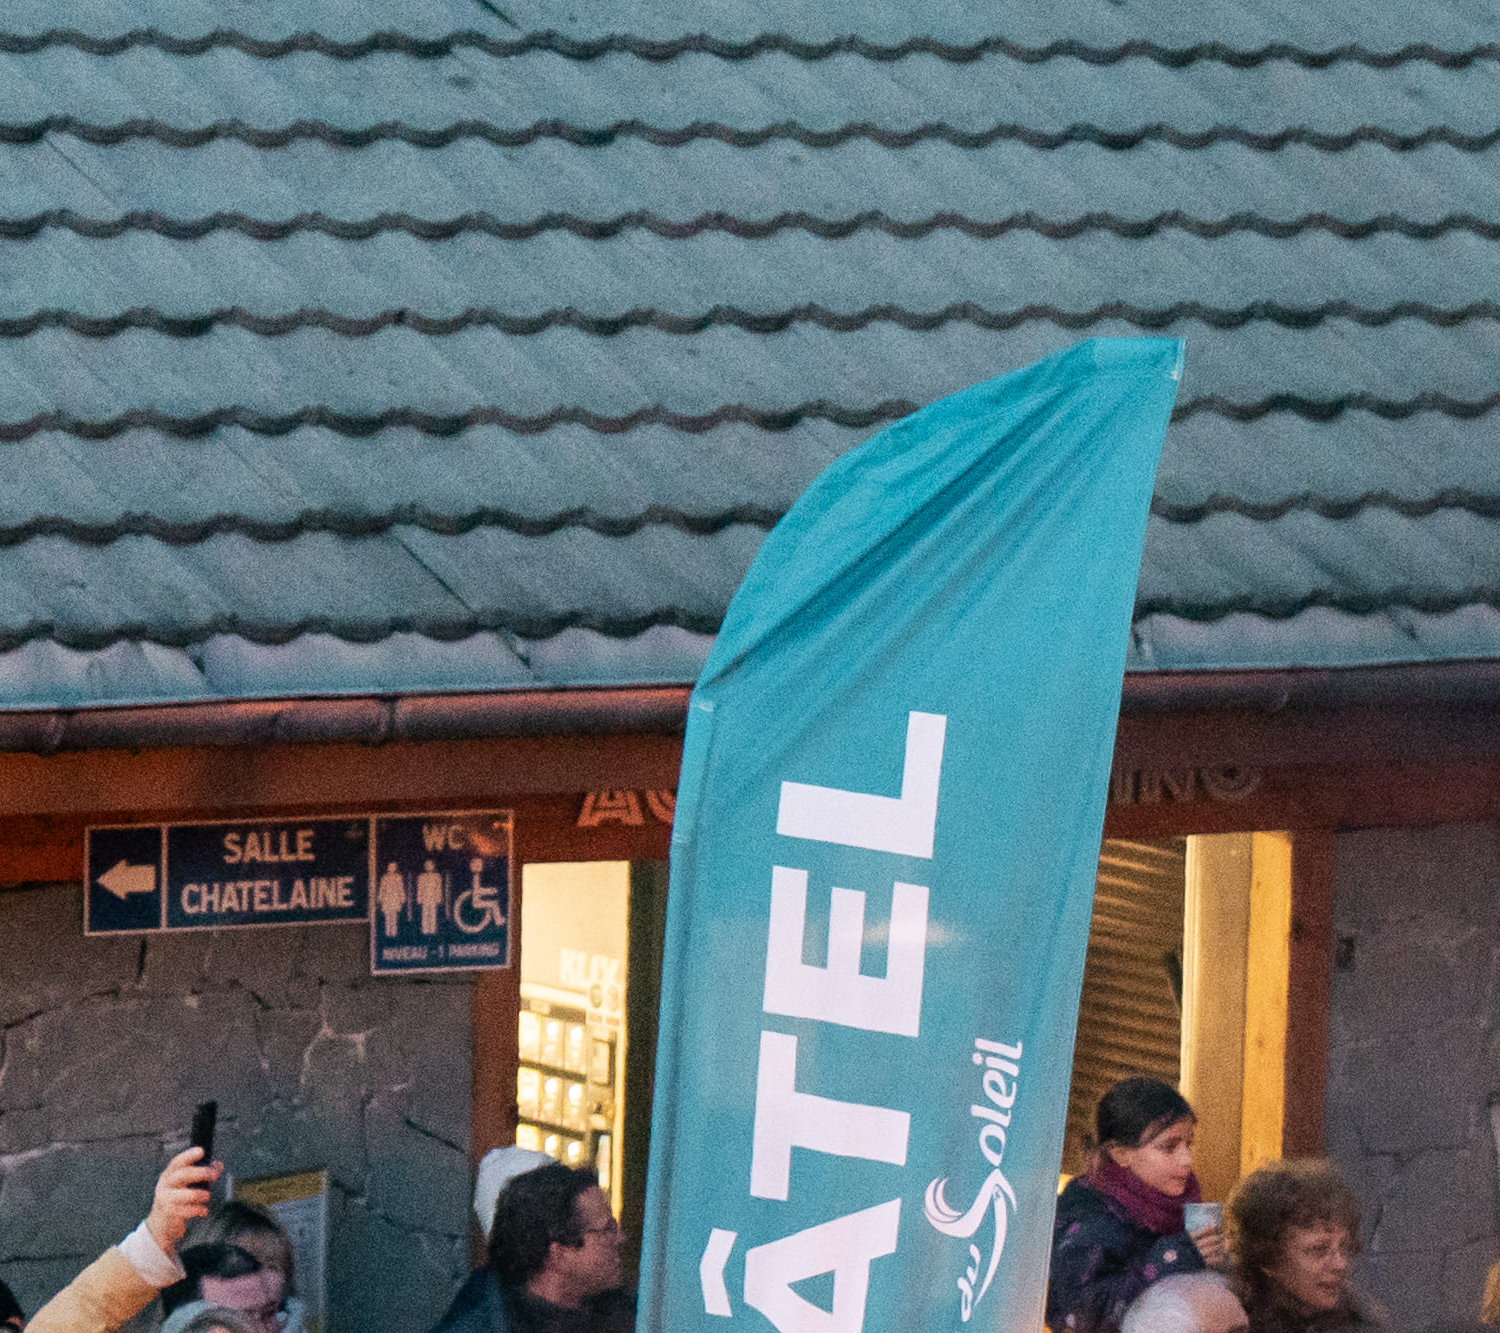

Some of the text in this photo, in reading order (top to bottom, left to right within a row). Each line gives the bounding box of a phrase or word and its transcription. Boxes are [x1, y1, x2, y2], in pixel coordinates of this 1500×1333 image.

[223, 829, 316, 863] SALLE
[423, 823, 466, 852] WC
[180, 875, 354, 914] CHATELAINE
[448, 942, 500, 957] PARKING
[924, 1037, 1023, 1307] Soleil
[960, 1243, 983, 1322] du
